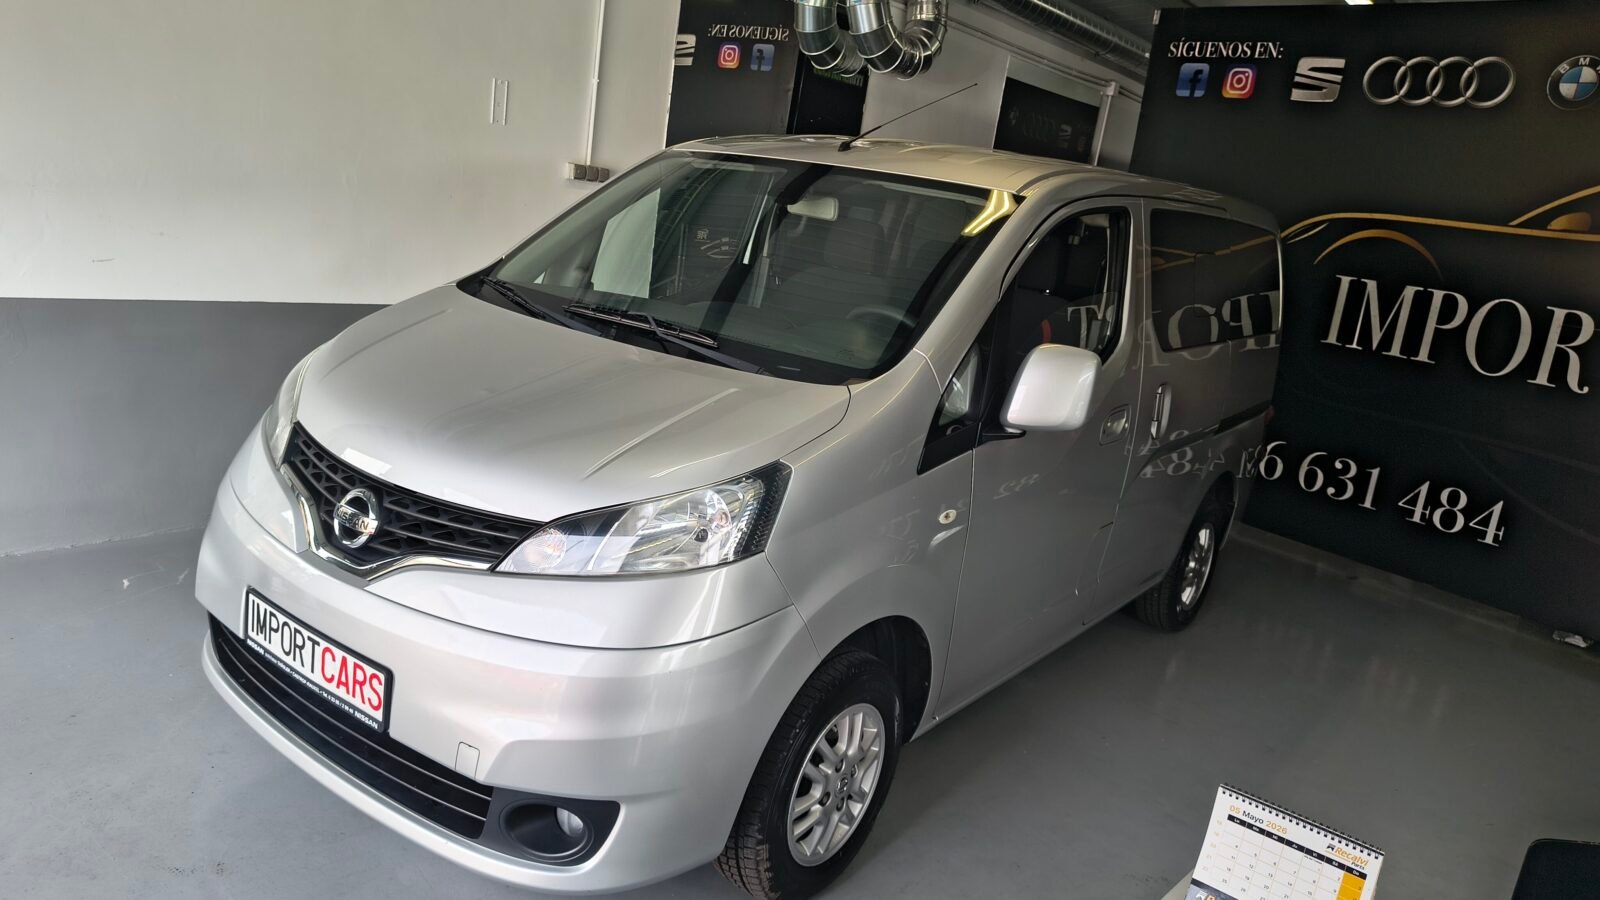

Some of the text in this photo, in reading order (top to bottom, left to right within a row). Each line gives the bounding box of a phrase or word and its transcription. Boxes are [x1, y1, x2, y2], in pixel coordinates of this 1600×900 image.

[1167, 38, 1284, 59] SÍGUENOS EN:
[1320, 274, 1595, 395] IMPOR
[1297, 451, 1382, 511] 631
[1397, 479, 1506, 547] 484
[354, 709, 379, 730] NISSAN
[1242, 810, 1265, 826] Mayo
[1265, 820, 1289, 836] 2026
[1334, 845, 1369, 867] Recalvi
